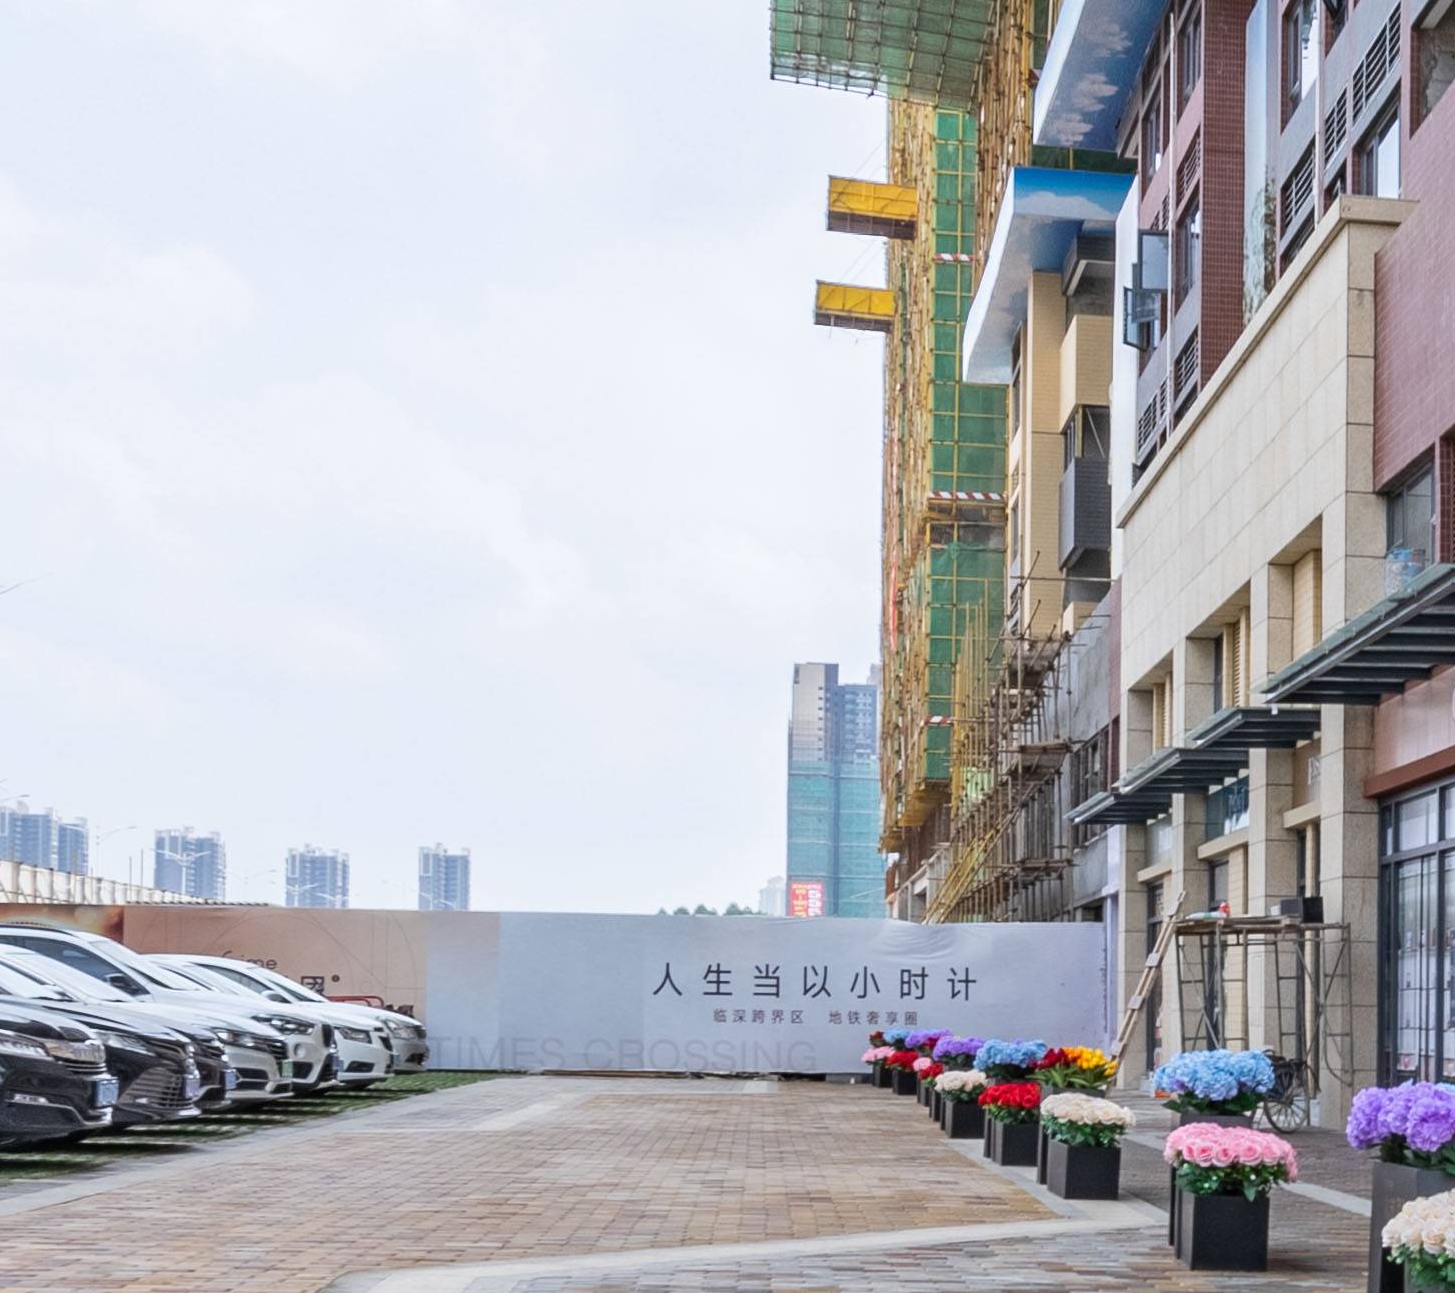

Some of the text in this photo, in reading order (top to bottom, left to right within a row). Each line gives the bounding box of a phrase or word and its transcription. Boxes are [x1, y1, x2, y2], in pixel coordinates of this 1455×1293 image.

[652, 962, 977, 1001] 人生当以小时计
[713, 1009, 803, 1024] 临深跨界区
[429, 1036, 817, 1070] TIMES CROSSING
